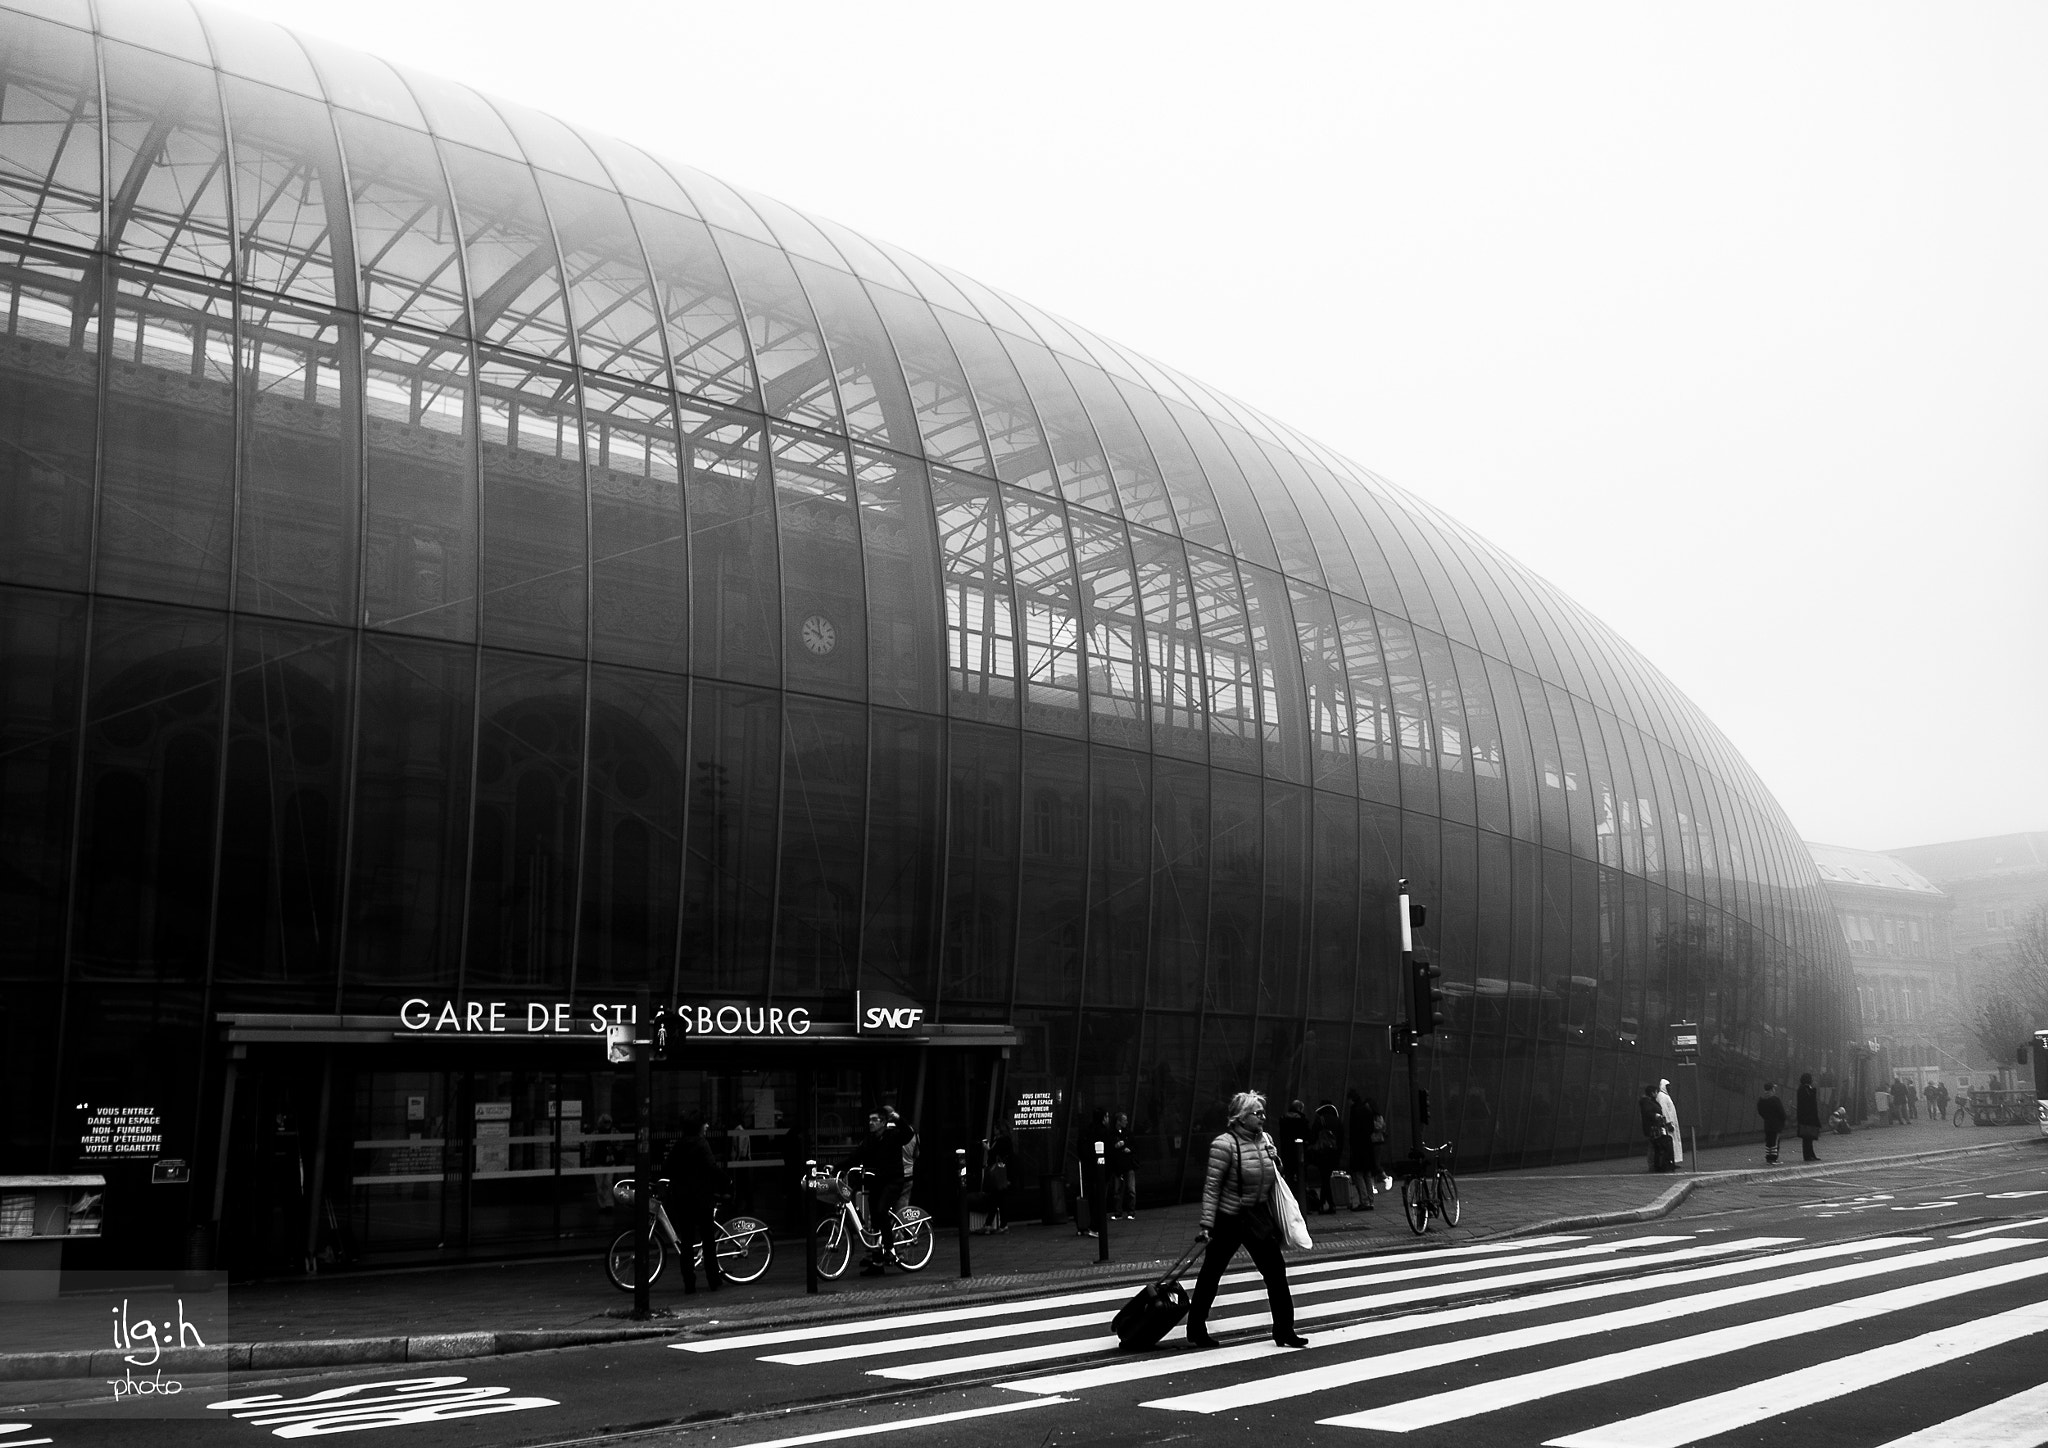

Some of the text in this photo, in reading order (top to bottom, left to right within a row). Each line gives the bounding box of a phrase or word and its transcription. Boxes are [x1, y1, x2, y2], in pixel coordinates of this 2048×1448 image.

[400, 998, 811, 1035] GARE DE STSBOURG
[863, 1007, 923, 1029] SNCF
[96, 1107, 155, 1116] VOUS ENTREZ
[87, 1116, 161, 1125] DANS UN ESPACE
[116, 1126, 152, 1134] FUMEUR
[81, 1135, 110, 1143] MERCI
[85, 1144, 161, 1153] VOTRE CIGARETTE
